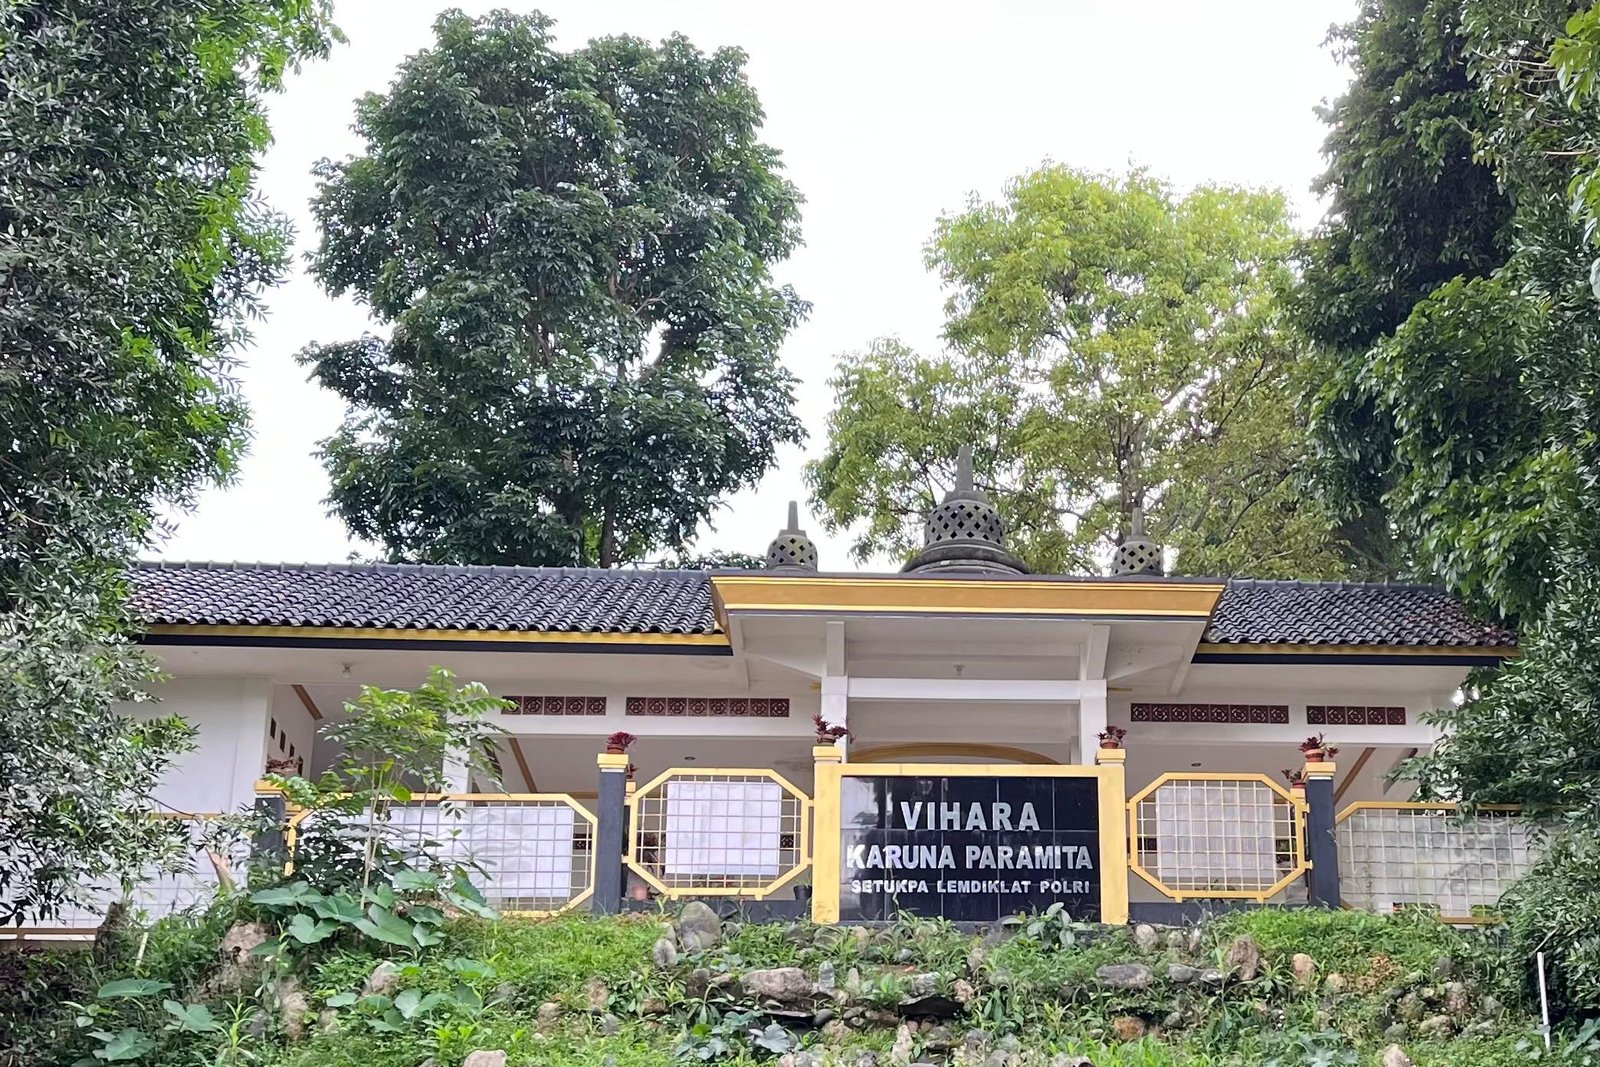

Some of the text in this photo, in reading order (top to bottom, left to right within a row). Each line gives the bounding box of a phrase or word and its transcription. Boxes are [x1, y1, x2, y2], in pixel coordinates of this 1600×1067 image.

[900, 801, 1040, 831] VIHARA
[846, 844, 1093, 869] KARUNA PARAMITA
[851, 879, 1090, 893] SETUKPA LEMDIKLAT POLRI
